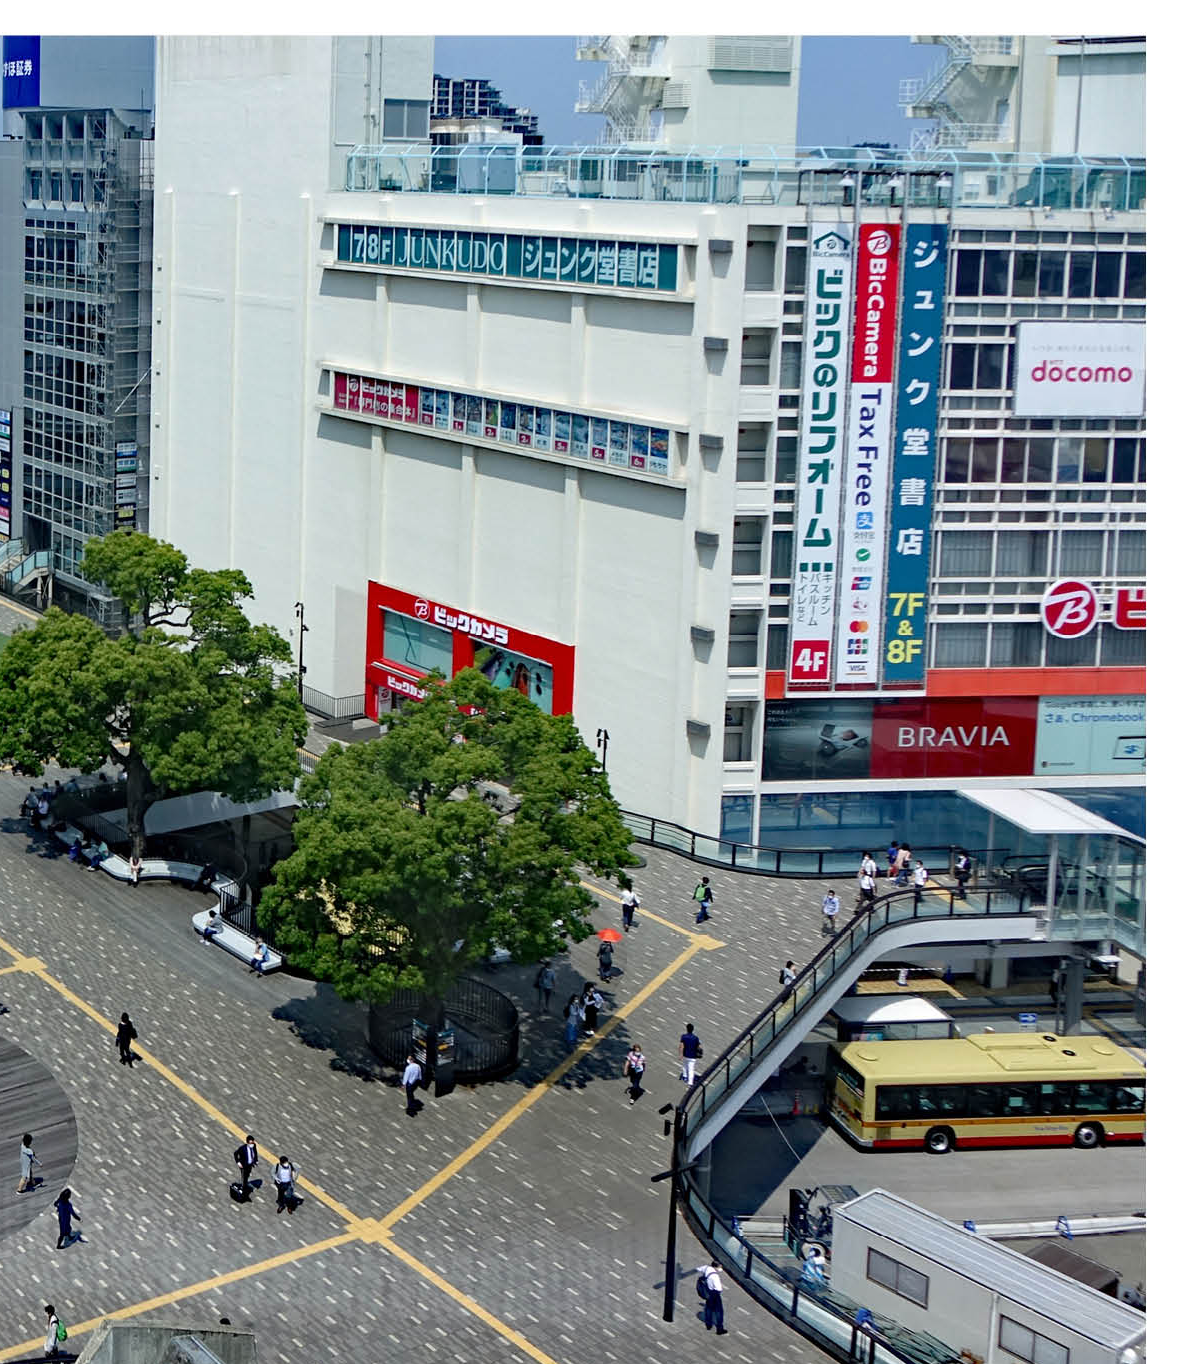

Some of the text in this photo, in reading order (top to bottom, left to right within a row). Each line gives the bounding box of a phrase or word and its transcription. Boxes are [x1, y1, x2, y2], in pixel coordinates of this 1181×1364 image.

[398, 233, 506, 271] JUNKUDO
[524, 235, 658, 285] ジュンク堂書店
[863, 257, 888, 378] BicCamera
[1031, 359, 1133, 383] docomo
[802, 268, 843, 548] ビックのリフォーム
[894, 239, 939, 557] ジュンク堂書店
[854, 387, 883, 506] Tax Free
[434, 605, 509, 645] ビックカメラ
[889, 593, 925, 617] 7F
[794, 648, 826, 672] 4F
[886, 639, 923, 664] 8F
[897, 726, 1011, 748] BRAVIA
